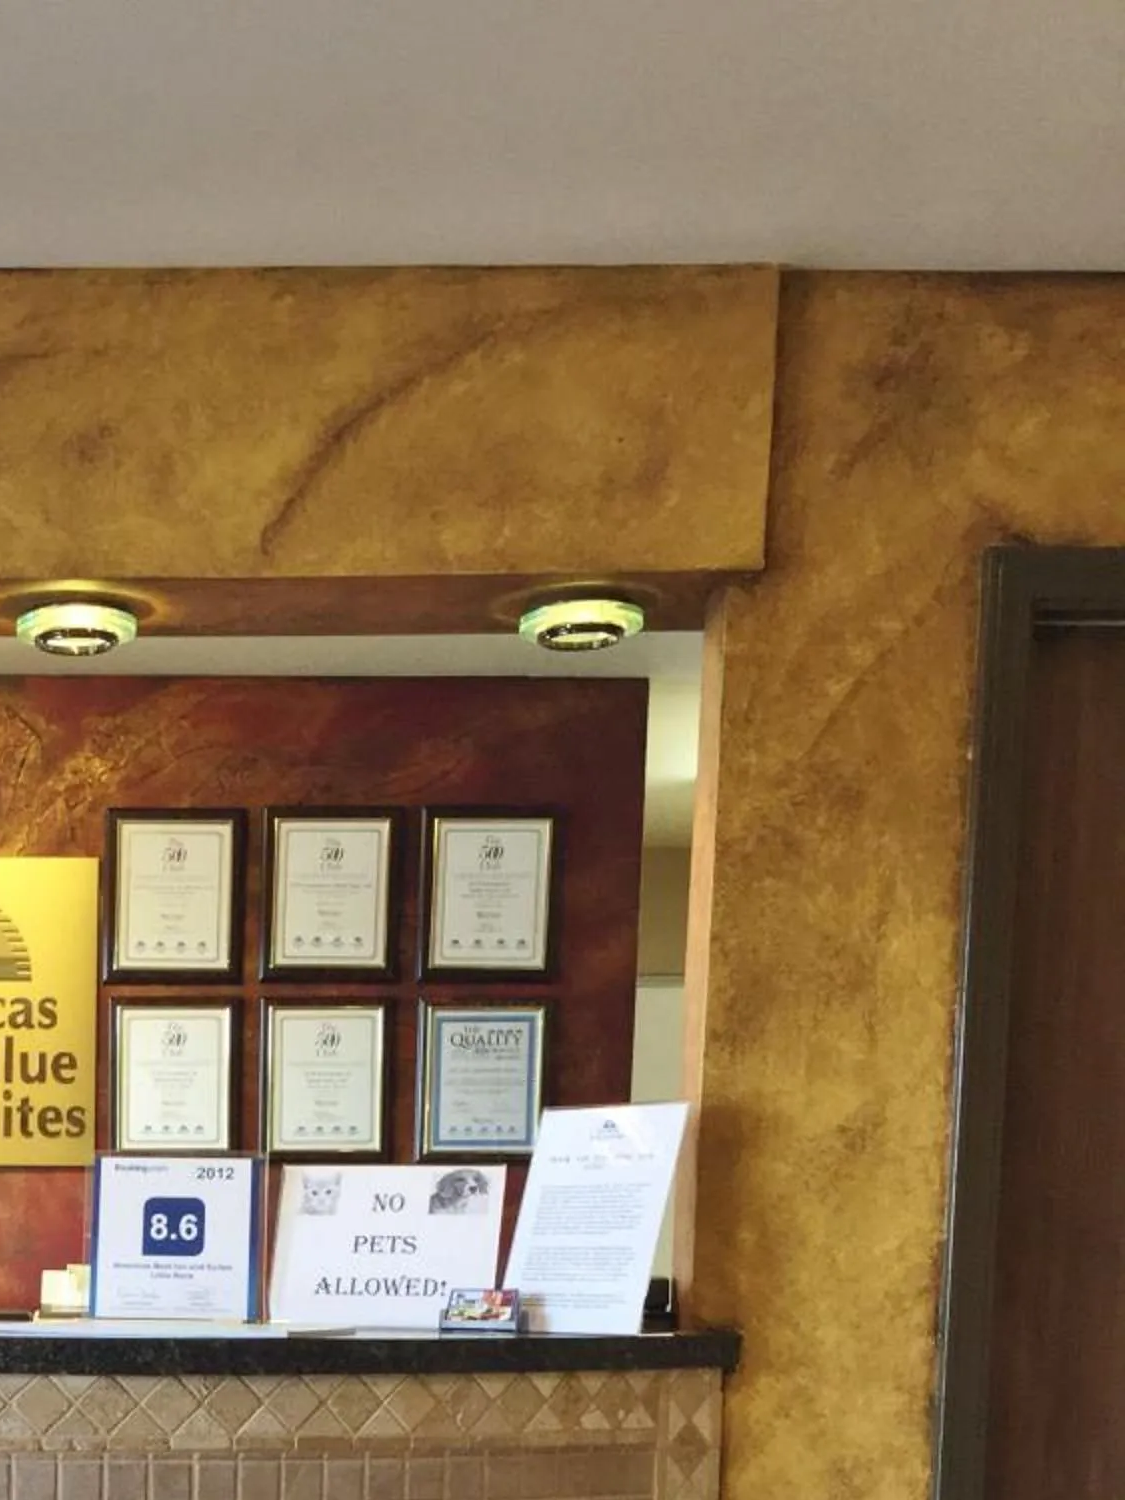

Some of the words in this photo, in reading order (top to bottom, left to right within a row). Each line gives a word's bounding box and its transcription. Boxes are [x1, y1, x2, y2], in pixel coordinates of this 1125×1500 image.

[449, 1028, 523, 1050] QUALITY
[195, 1166, 235, 1181] 2012
[372, 1193, 406, 1214] NO
[149, 1213, 199, 1242] 8.6
[351, 1235, 418, 1255] PETS
[314, 1275, 448, 1298] ALLOWED!
